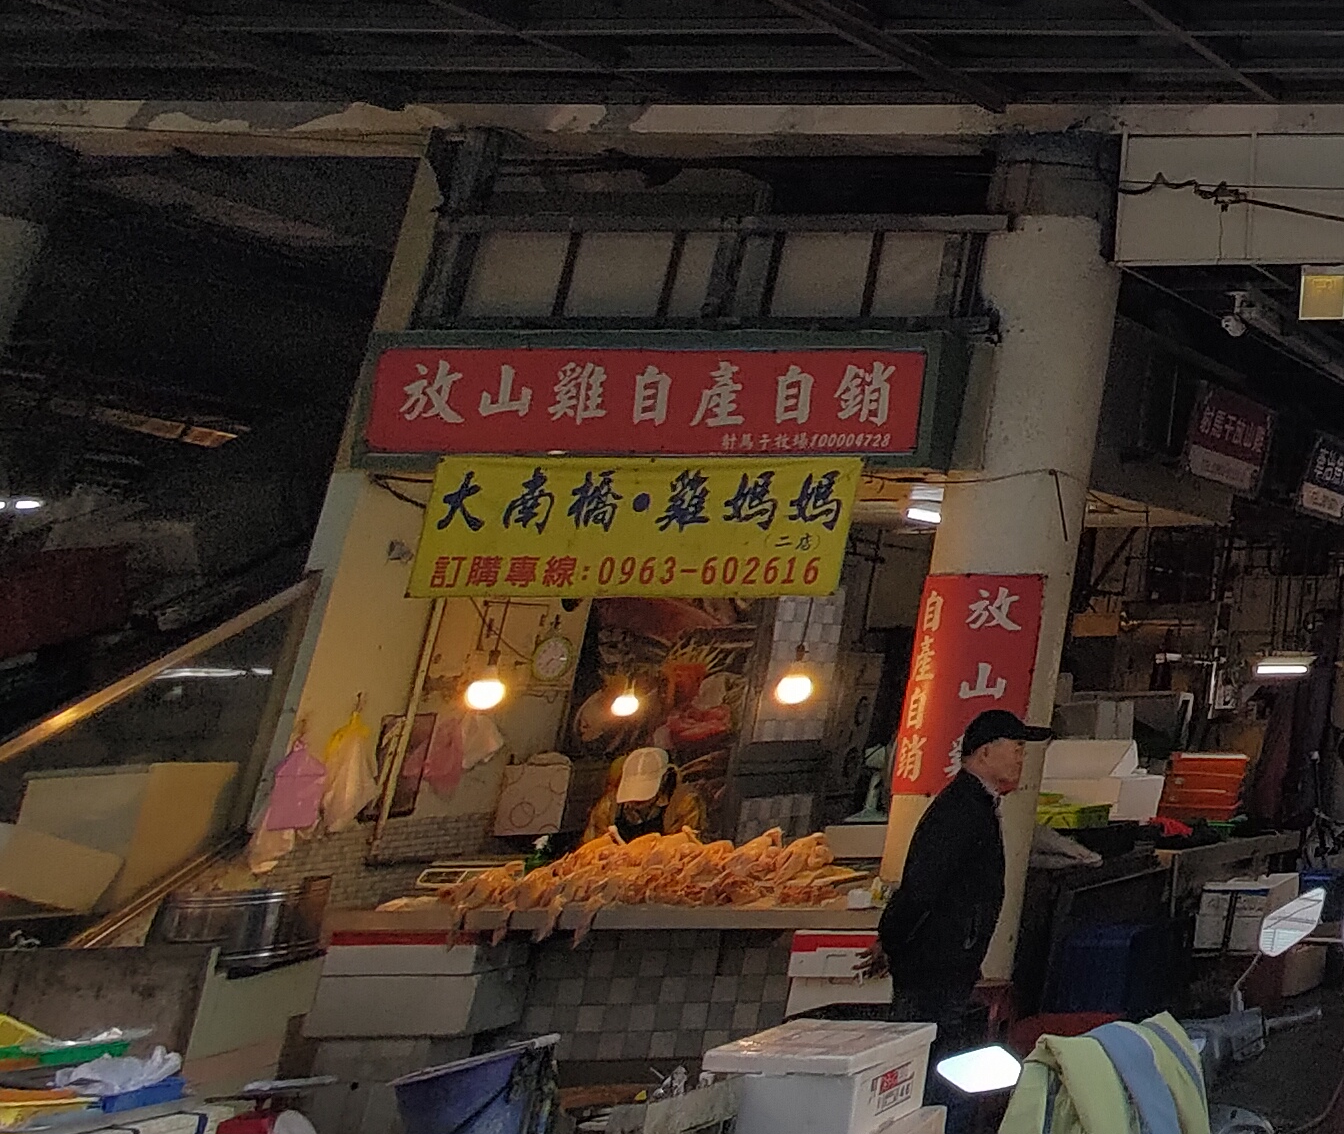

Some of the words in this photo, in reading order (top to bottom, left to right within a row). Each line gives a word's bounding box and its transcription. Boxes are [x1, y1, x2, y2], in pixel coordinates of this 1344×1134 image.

[400, 359, 896, 430] 放山雞自產自銷
